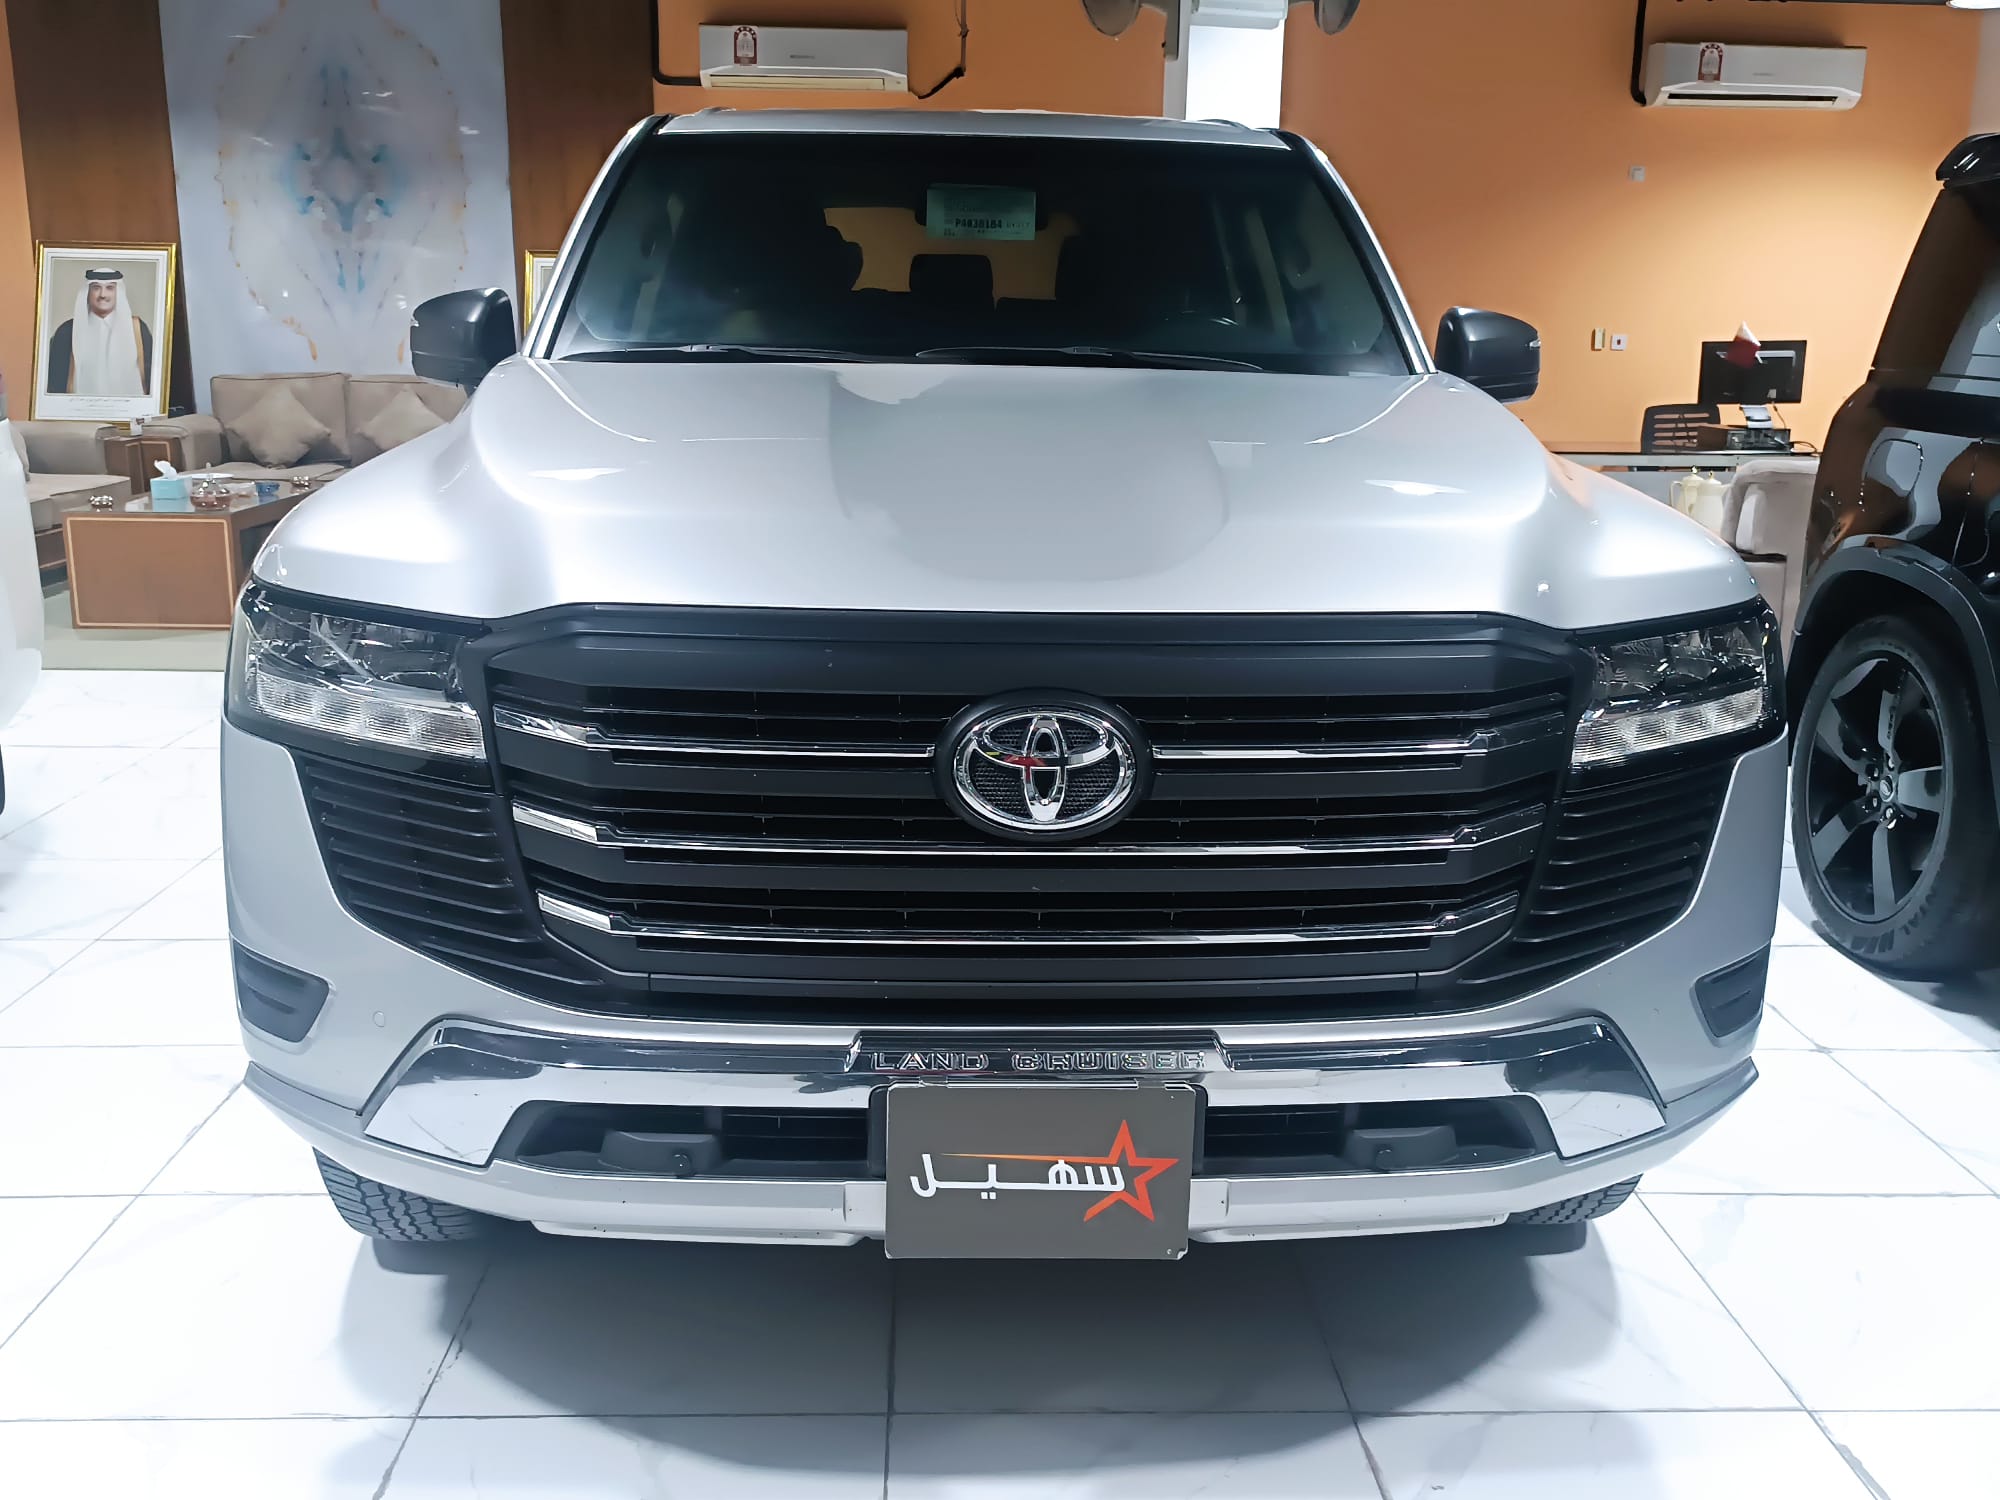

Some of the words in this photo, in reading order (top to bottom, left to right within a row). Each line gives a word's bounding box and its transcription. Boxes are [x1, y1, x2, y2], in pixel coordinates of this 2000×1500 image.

[871, 1051, 988, 1071] LAND
[1012, 1051, 1205, 1071] CRUISER
[910, 1153, 1125, 1200] سهيل
